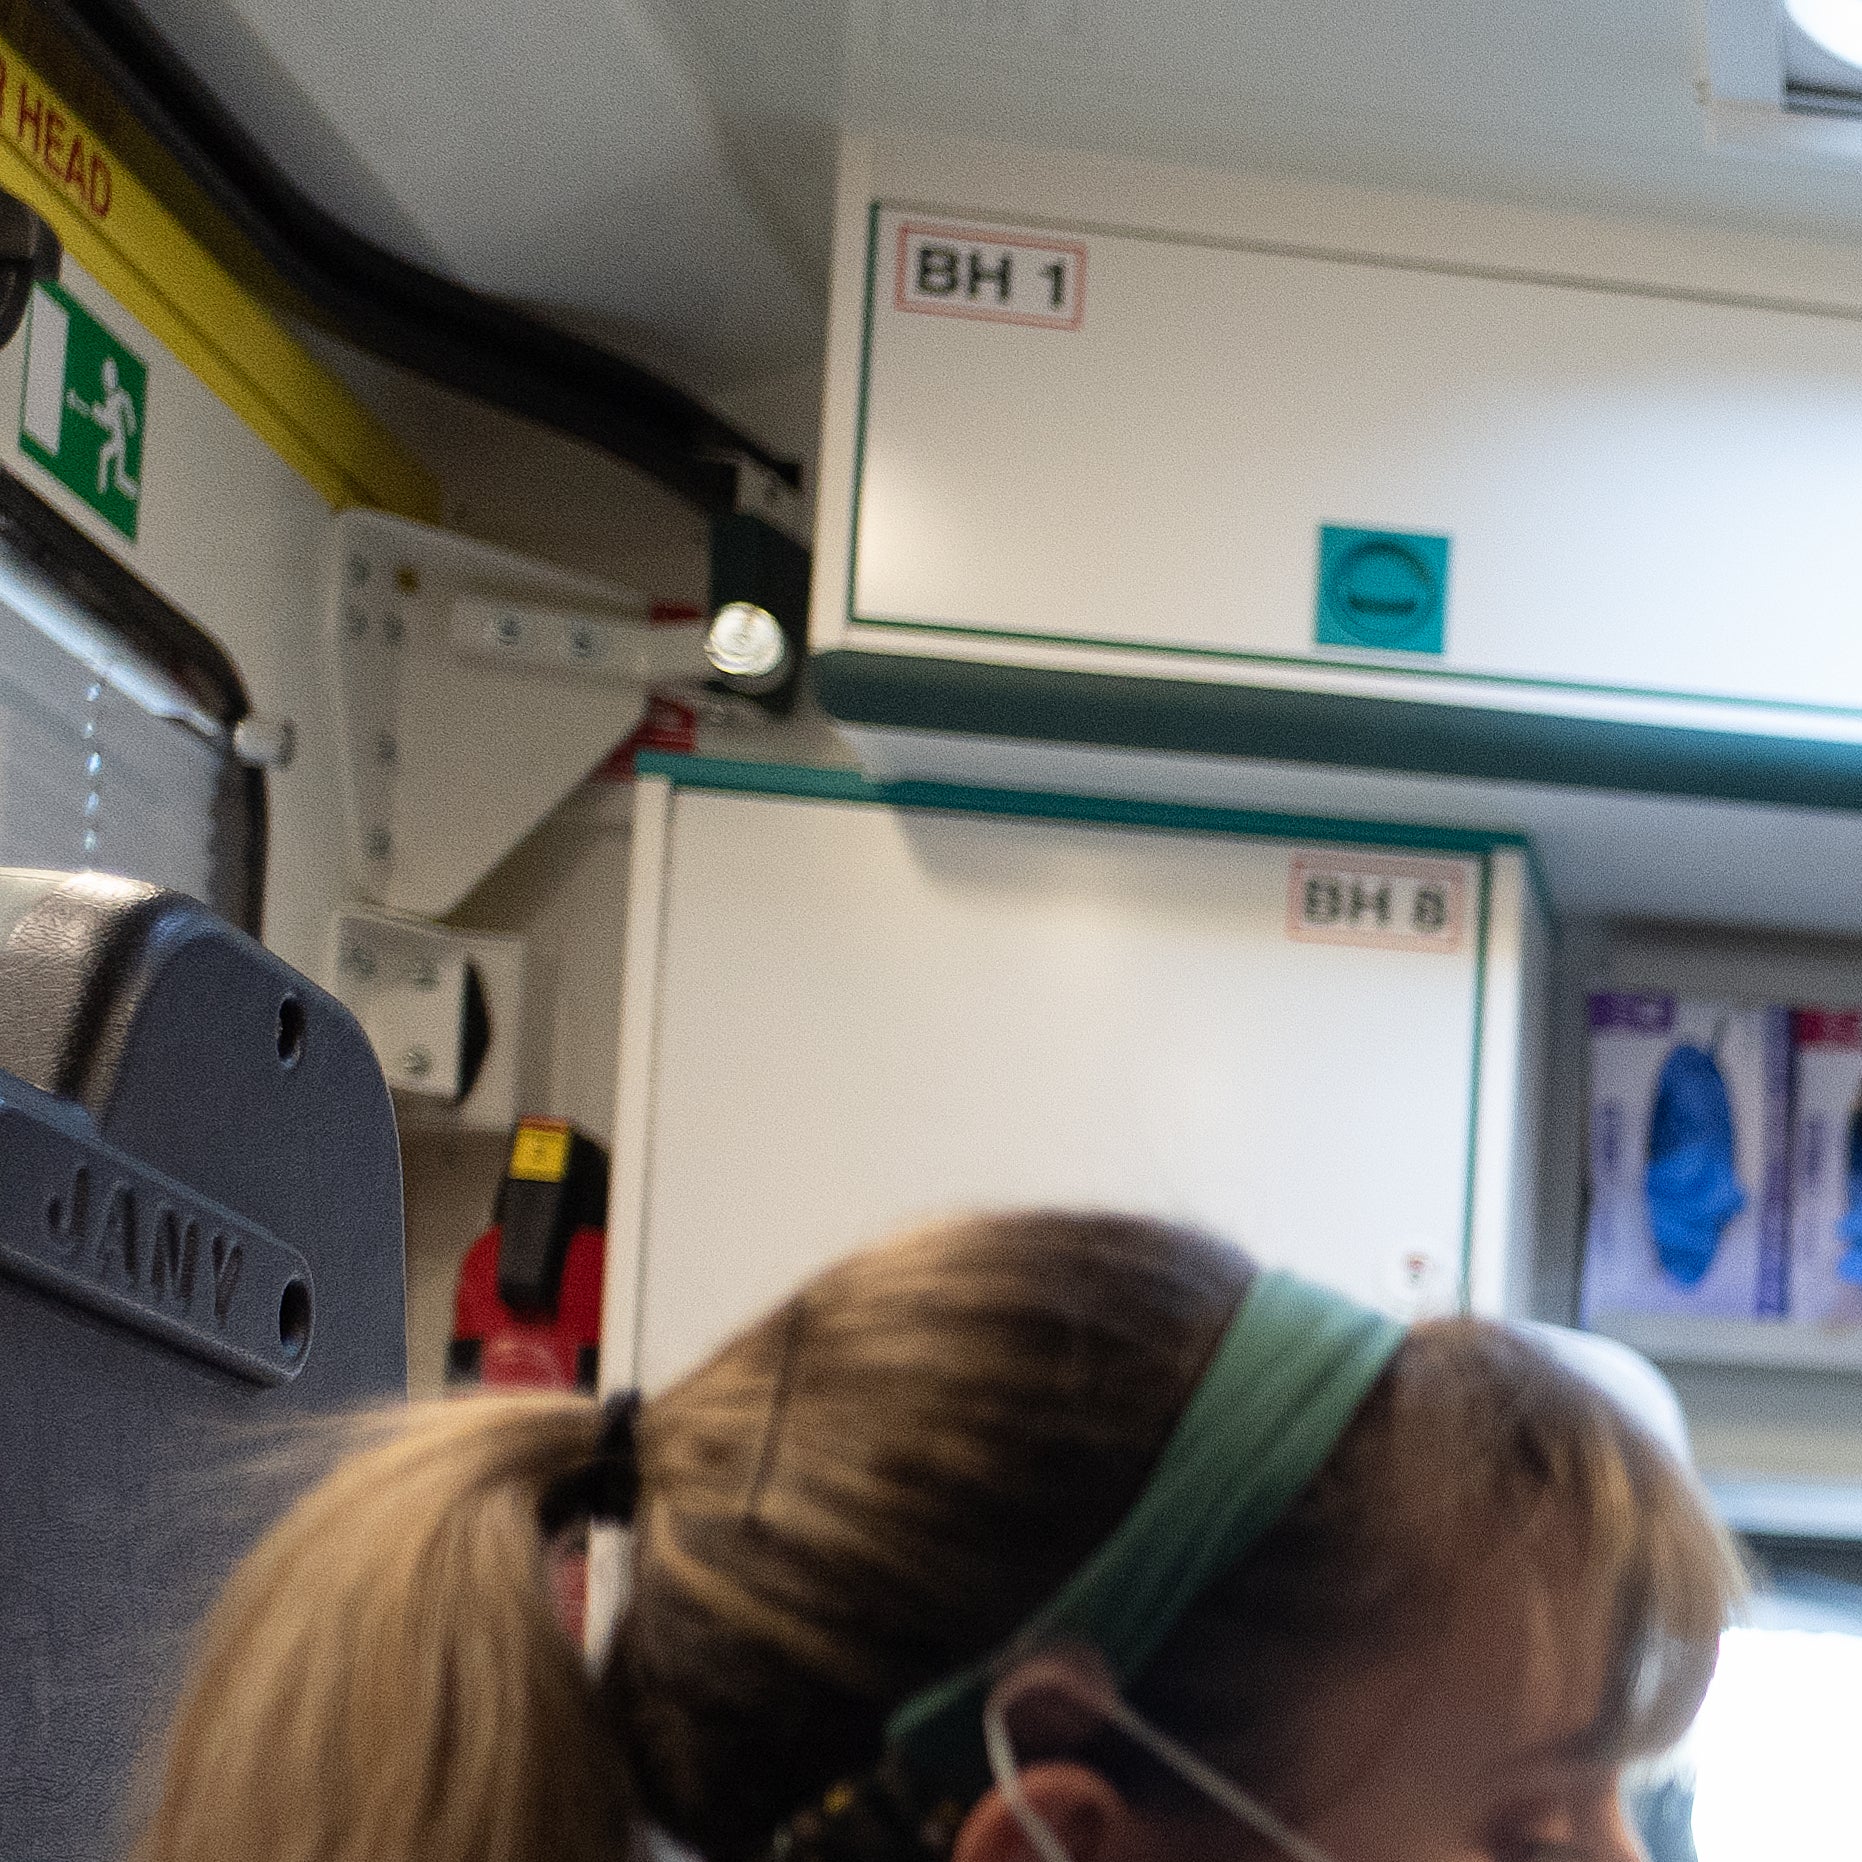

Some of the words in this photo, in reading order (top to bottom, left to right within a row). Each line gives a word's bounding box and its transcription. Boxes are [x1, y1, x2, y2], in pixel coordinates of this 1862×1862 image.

[18, 83, 113, 217] HEAD
[918, 246, 1012, 303] BH
[1041, 261, 1066, 309] 1
[1304, 877, 1393, 928] BH
[49, 1166, 245, 1330] JANY
